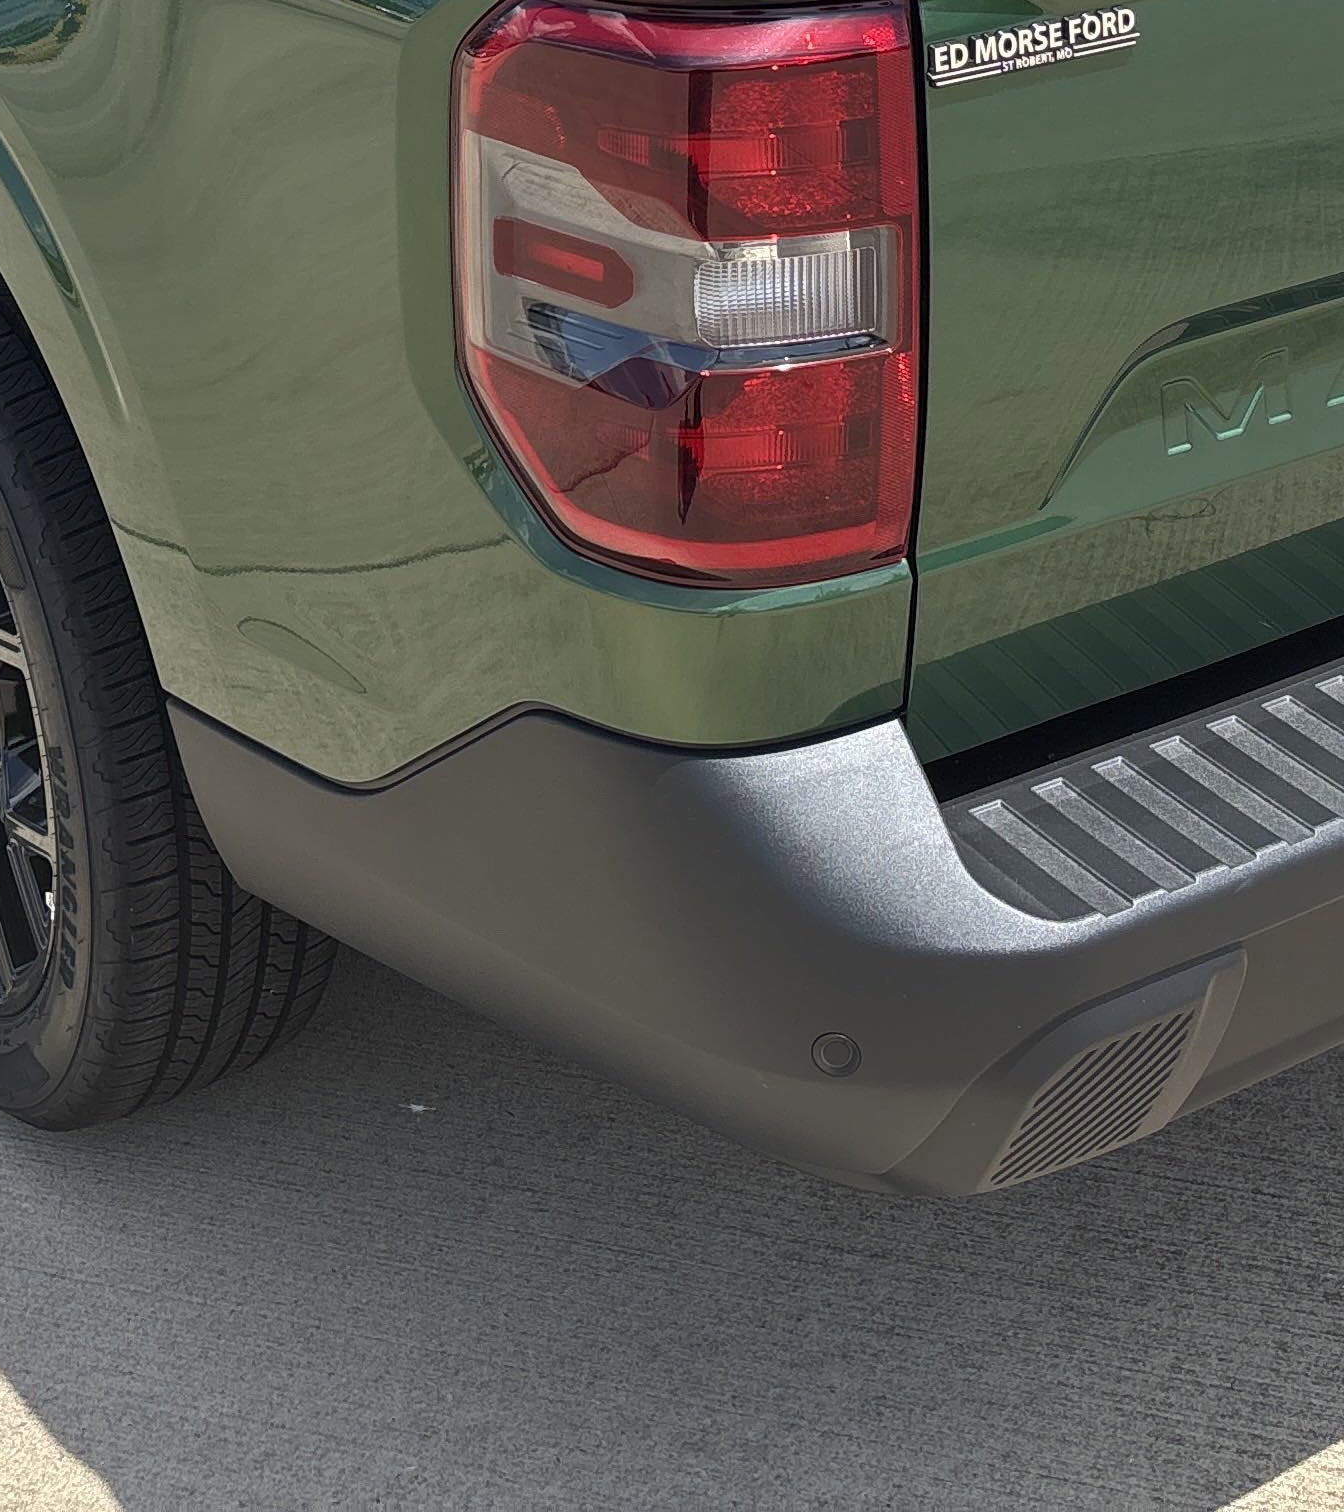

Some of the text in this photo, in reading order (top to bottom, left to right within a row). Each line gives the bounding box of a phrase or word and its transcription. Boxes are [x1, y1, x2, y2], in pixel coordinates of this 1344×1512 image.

[934, 7, 1136, 73] ED MORSE FORD
[1001, 60, 1014, 73] ST
[1056, 47, 1073, 61] MO
[48, 745, 77, 990] WRANGLER
